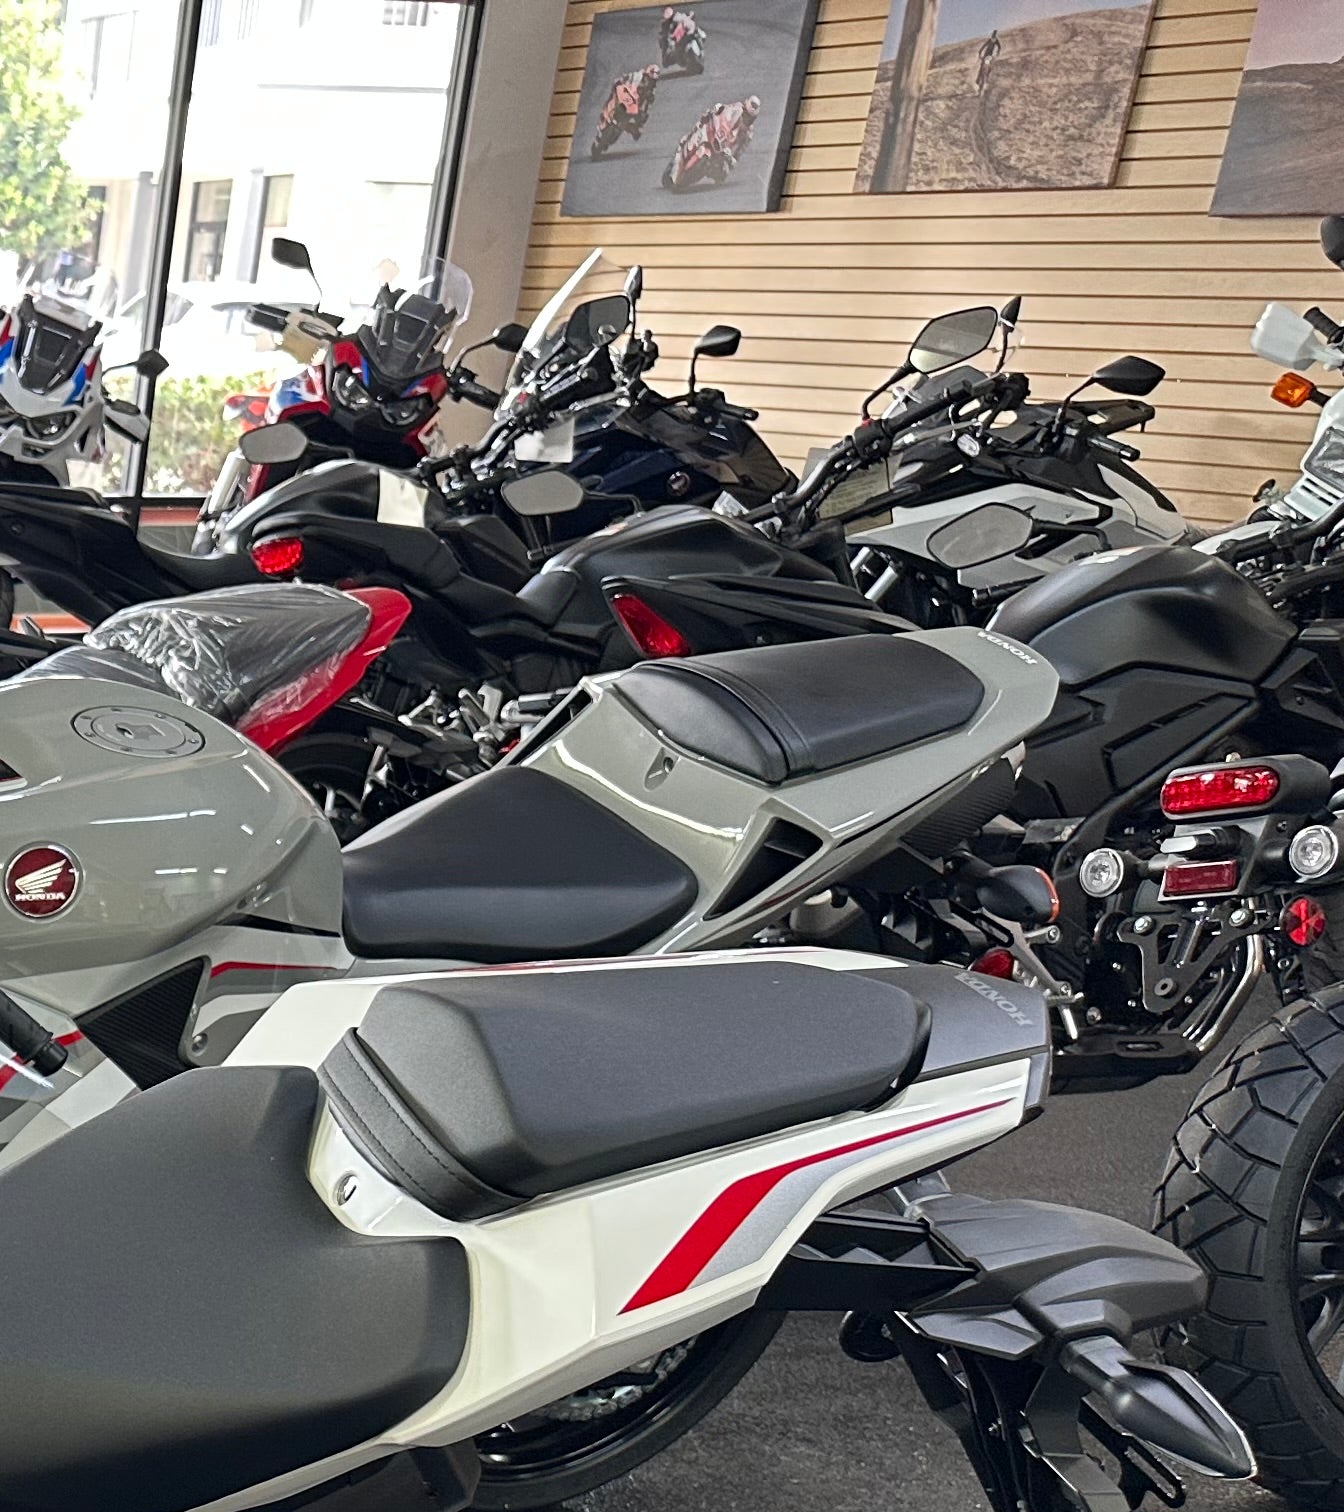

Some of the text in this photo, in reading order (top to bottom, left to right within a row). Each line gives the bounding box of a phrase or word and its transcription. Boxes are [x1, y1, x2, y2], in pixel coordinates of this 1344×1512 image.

[977, 631, 1037, 664] HONDA
[15, 892, 66, 901] HONDA
[954, 972, 1033, 1026] HONDA
